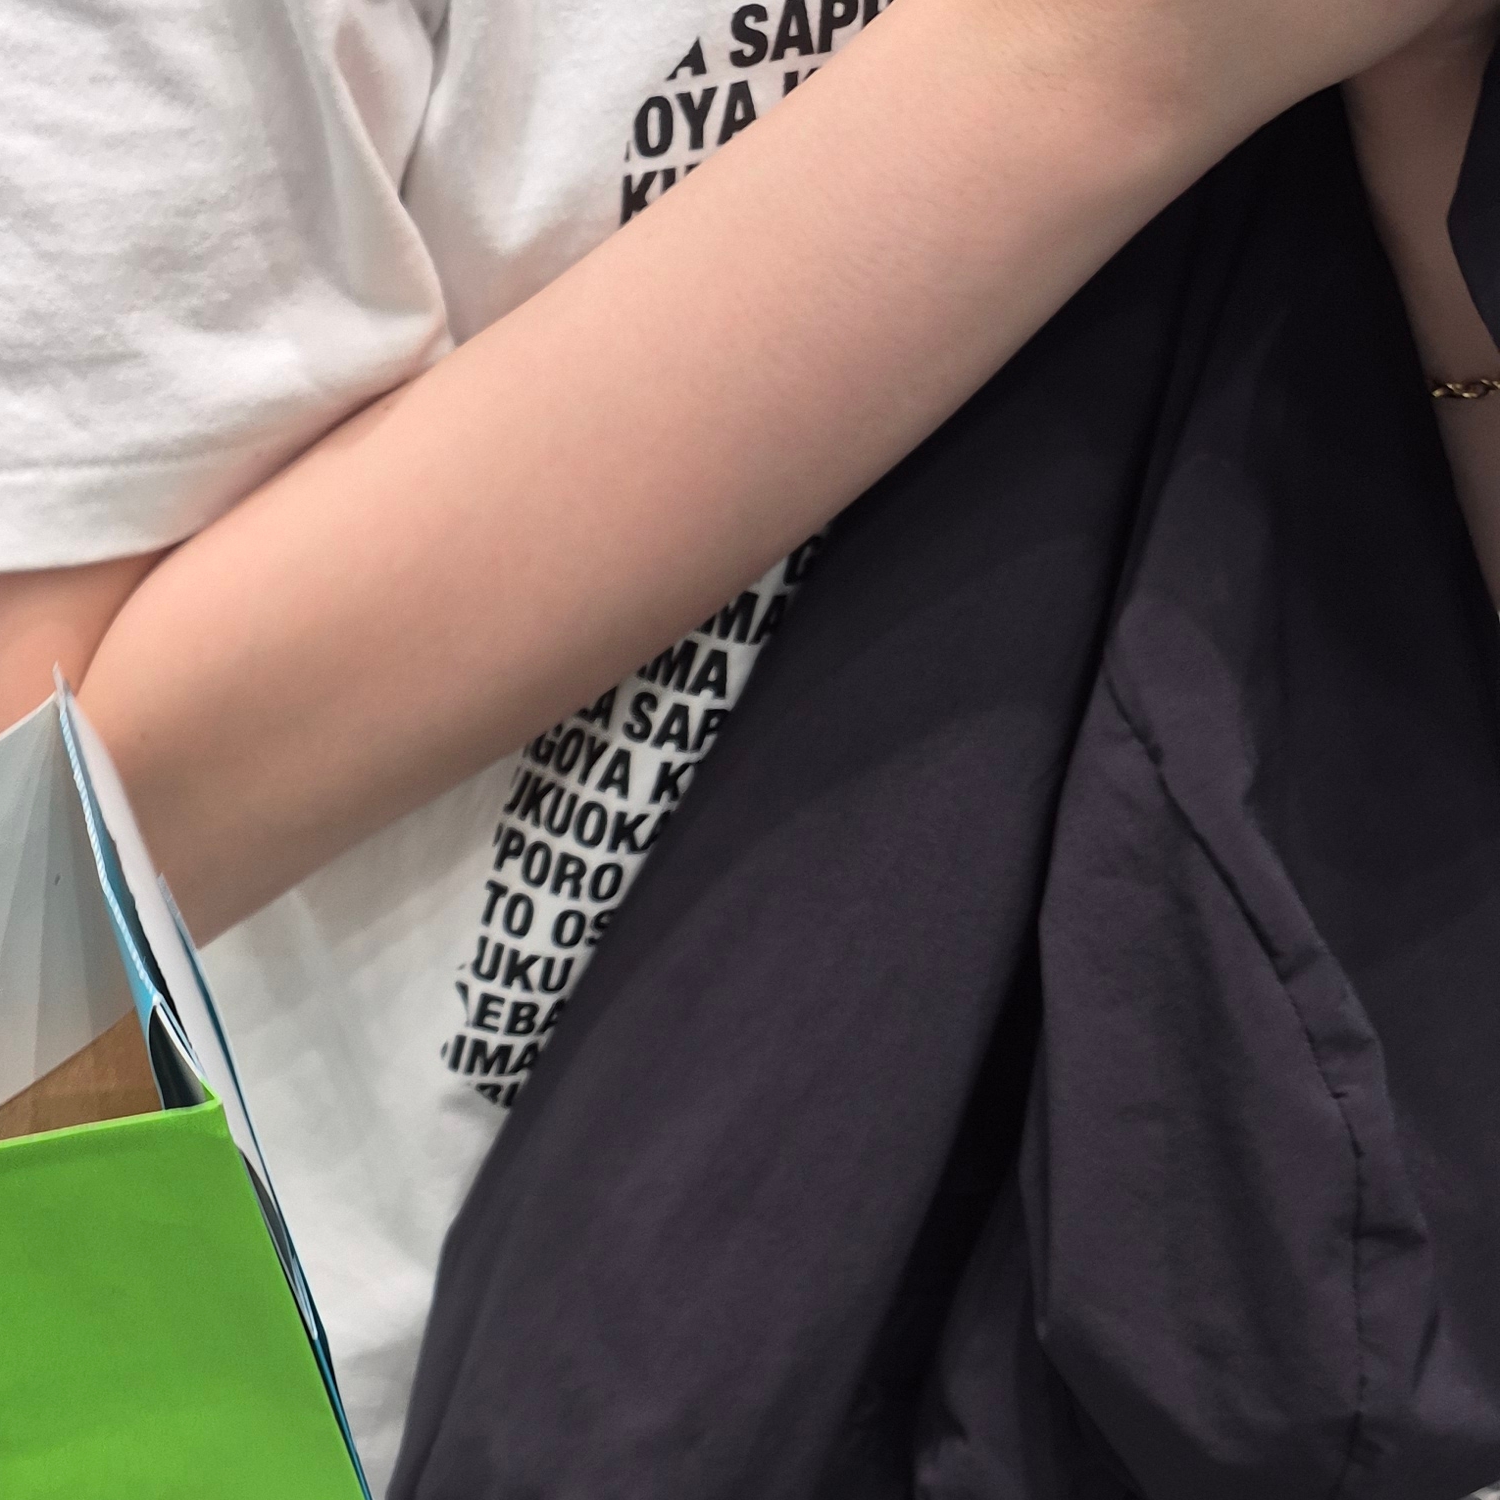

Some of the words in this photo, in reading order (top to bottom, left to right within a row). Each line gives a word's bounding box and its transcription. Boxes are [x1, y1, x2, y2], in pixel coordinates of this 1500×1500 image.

[624, 80, 757, 159] OYA
[637, 639, 727, 699] MA
[523, 723, 631, 799] GOYA
[493, 823, 624, 903] PORO
[480, 880, 534, 939] TO
[457, 936, 575, 994] UKU
[441, 1034, 539, 1077] IMA
